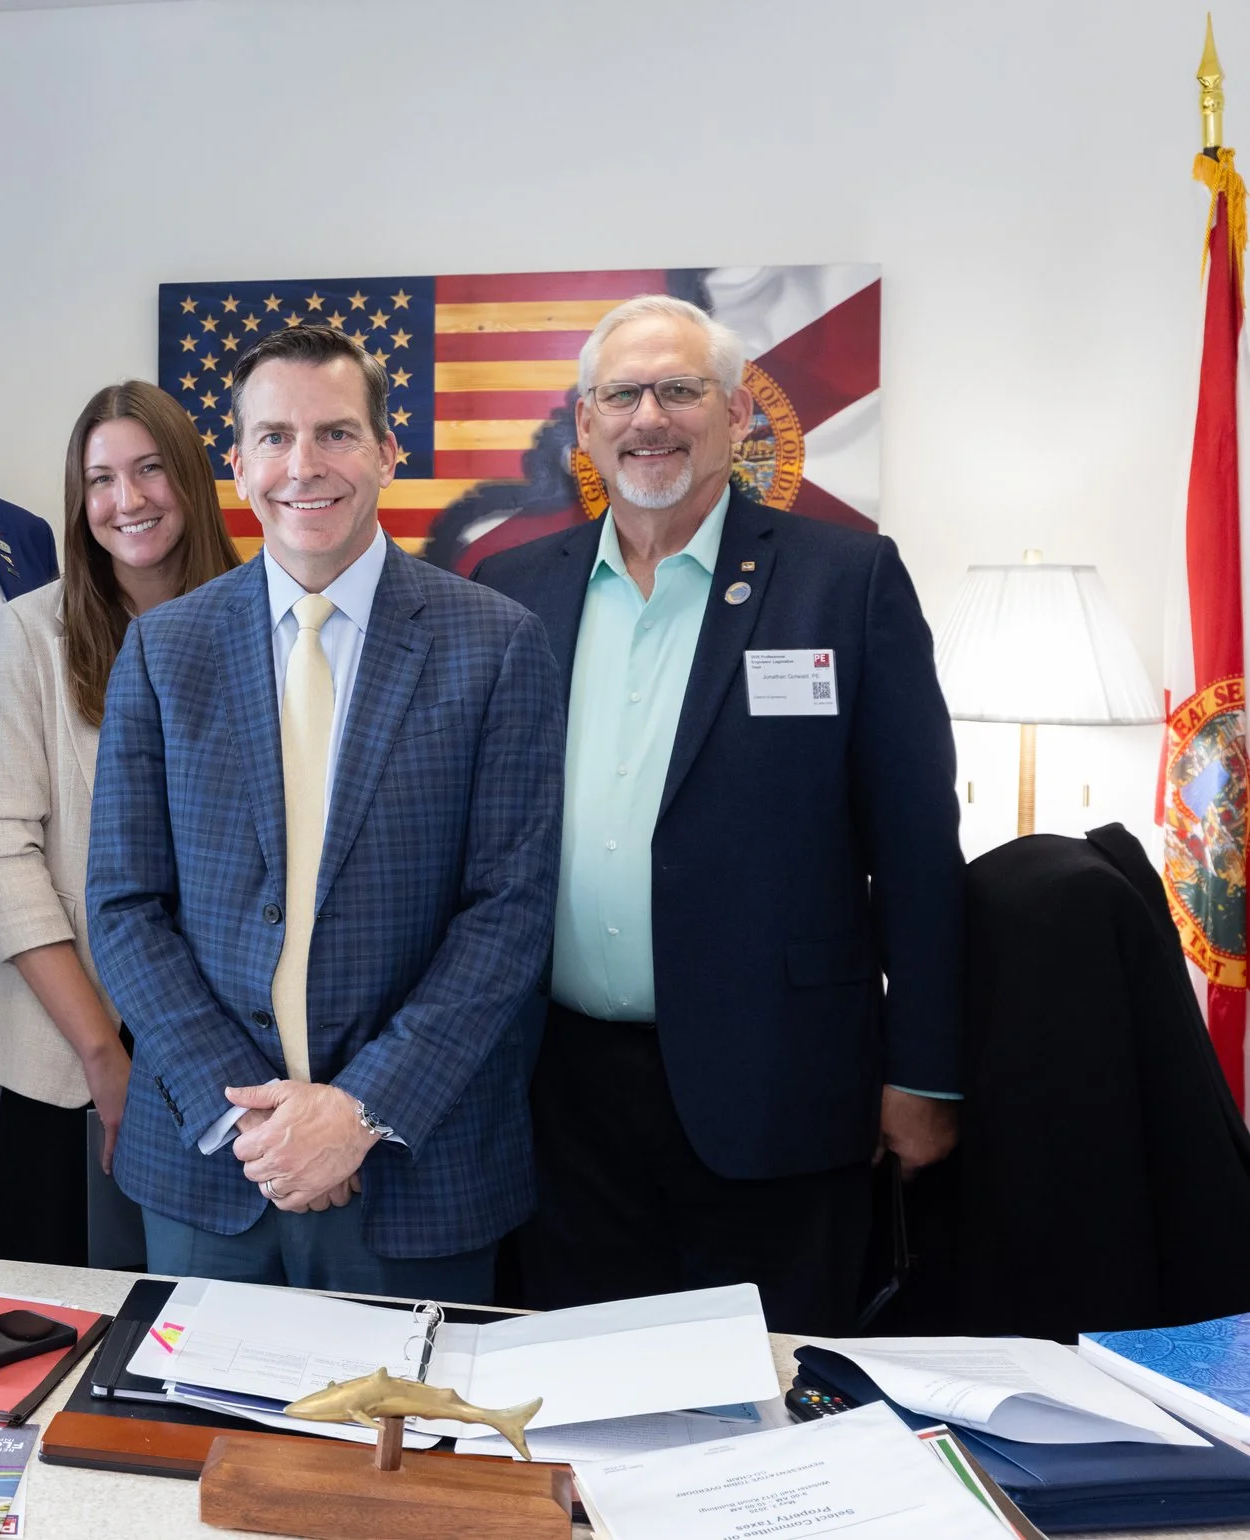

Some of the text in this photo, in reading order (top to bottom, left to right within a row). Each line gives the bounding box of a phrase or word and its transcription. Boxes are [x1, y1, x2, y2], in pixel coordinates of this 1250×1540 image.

[758, 386, 784, 408] OF
[814, 654, 826, 662] PE
[1213, 682, 1244, 708] SE
[676, 1485, 722, 1498] OVERDORF
[735, 1505, 831, 1531] Property Taxes
[814, 1508, 855, 1523] Select
[742, 1519, 813, 1538] Committee
